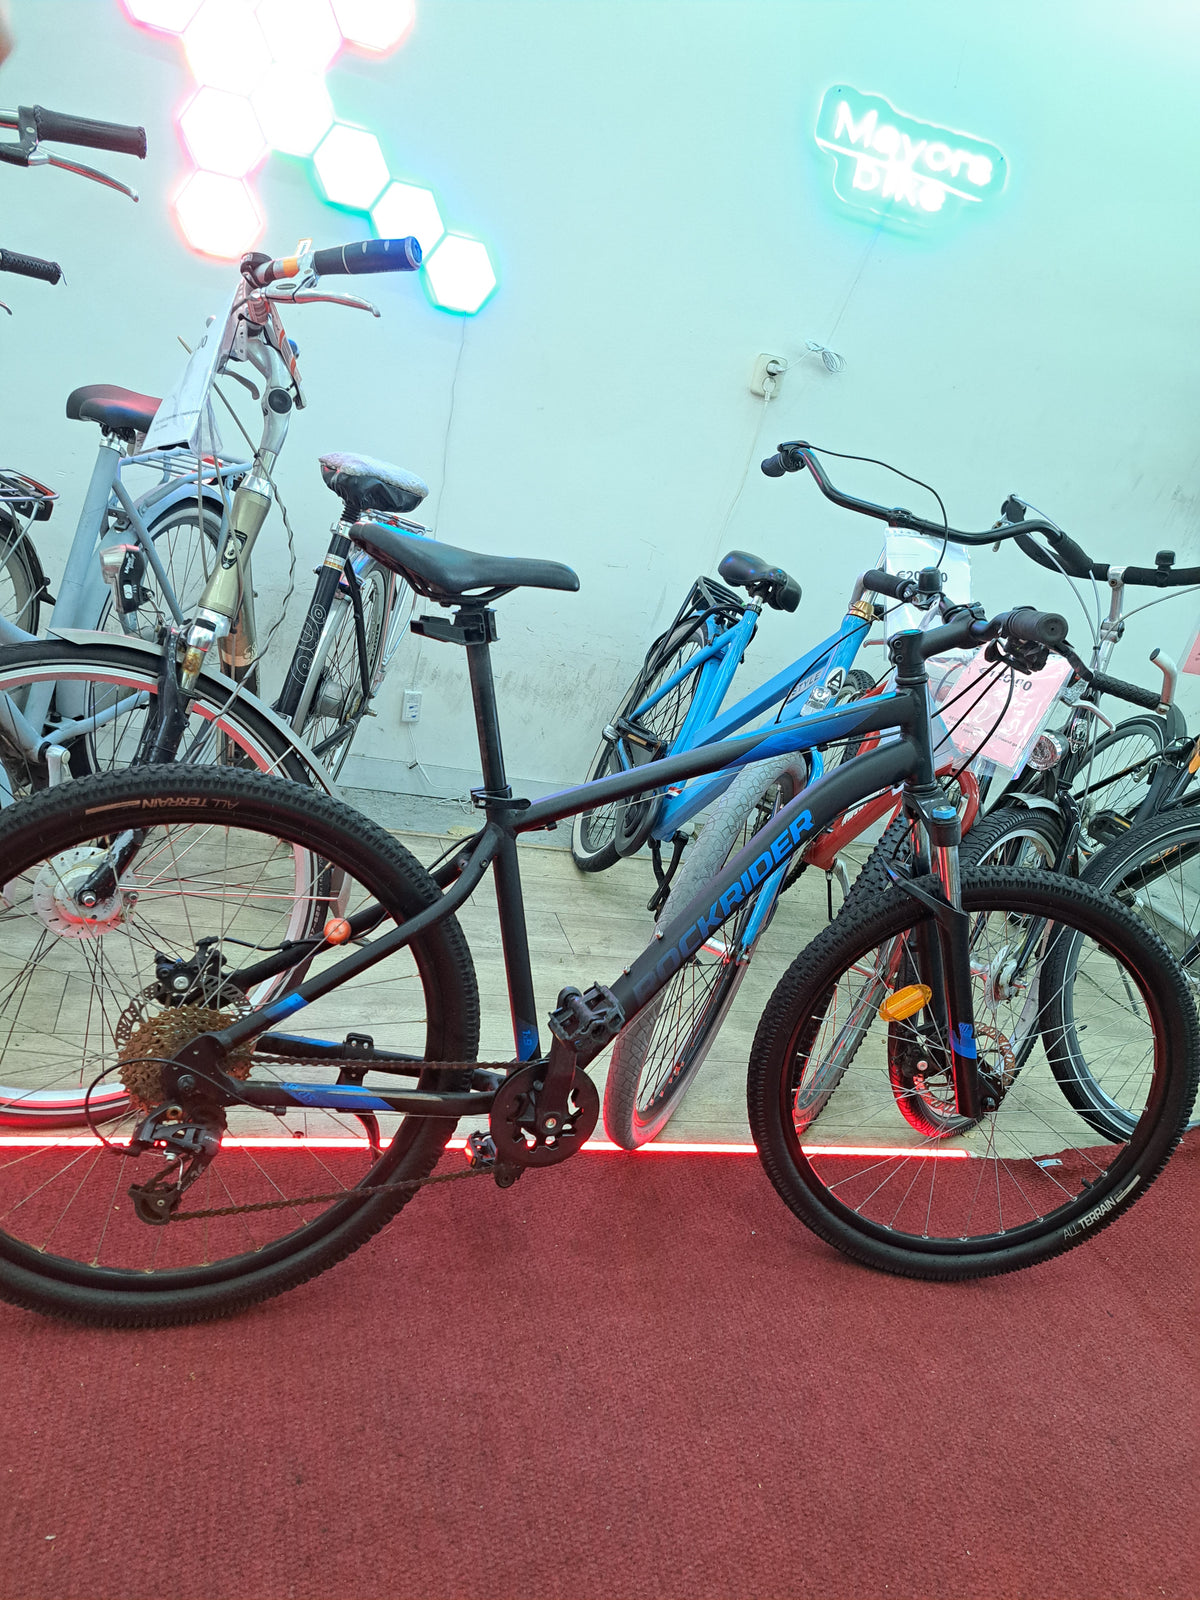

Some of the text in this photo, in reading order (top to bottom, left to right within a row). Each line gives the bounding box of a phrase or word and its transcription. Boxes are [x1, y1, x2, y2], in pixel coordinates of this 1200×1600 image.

[141, 796, 239, 810] ALL TERRAIN
[1062, 1196, 1117, 1240] ALL TERRAIN
